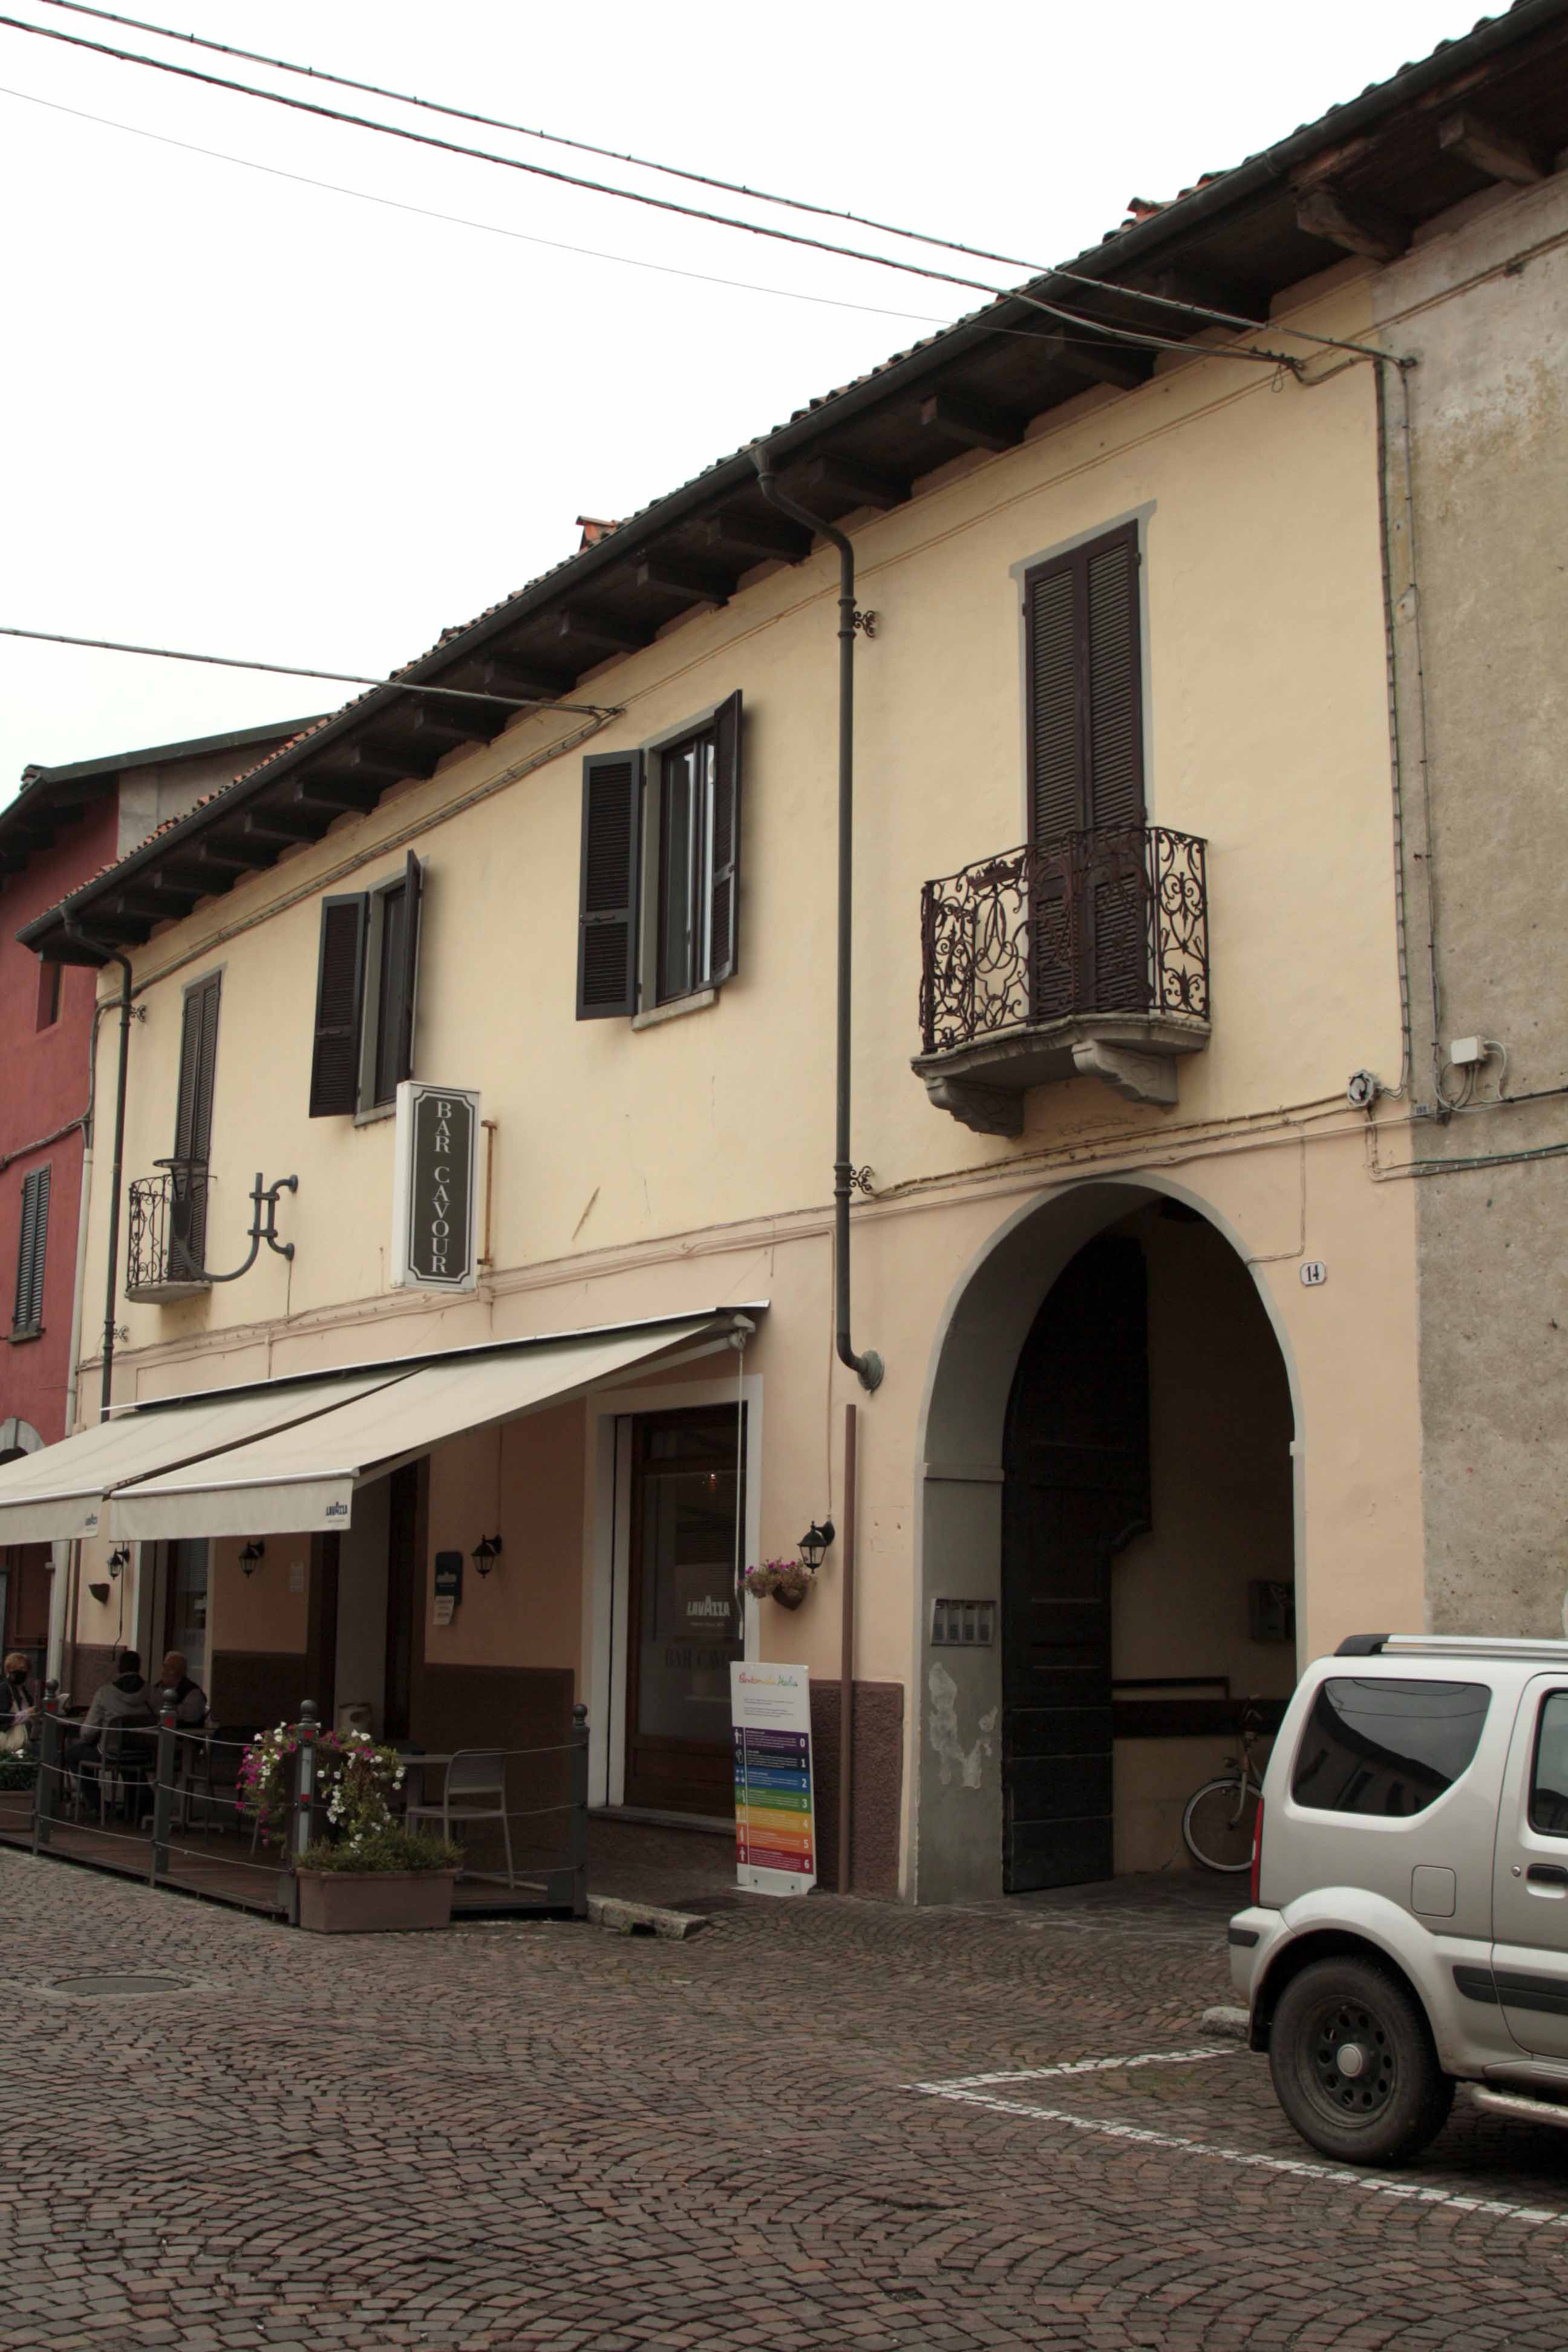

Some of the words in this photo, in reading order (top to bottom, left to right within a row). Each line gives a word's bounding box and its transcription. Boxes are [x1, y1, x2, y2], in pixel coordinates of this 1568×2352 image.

[434, 1101, 452, 1154] BAR
[431, 1166, 451, 1274] CAVOUR
[1307, 1264, 1320, 1282] 14
[687, 1595, 730, 1616] LAVAZZA
[800, 1737, 806, 1748] 0
[801, 1758, 806, 1768] 1
[802, 1778, 808, 1788] 2
[802, 1798, 808, 1809] 3
[804, 1839, 809, 1849] 5
[804, 1859, 810, 1869] 6
